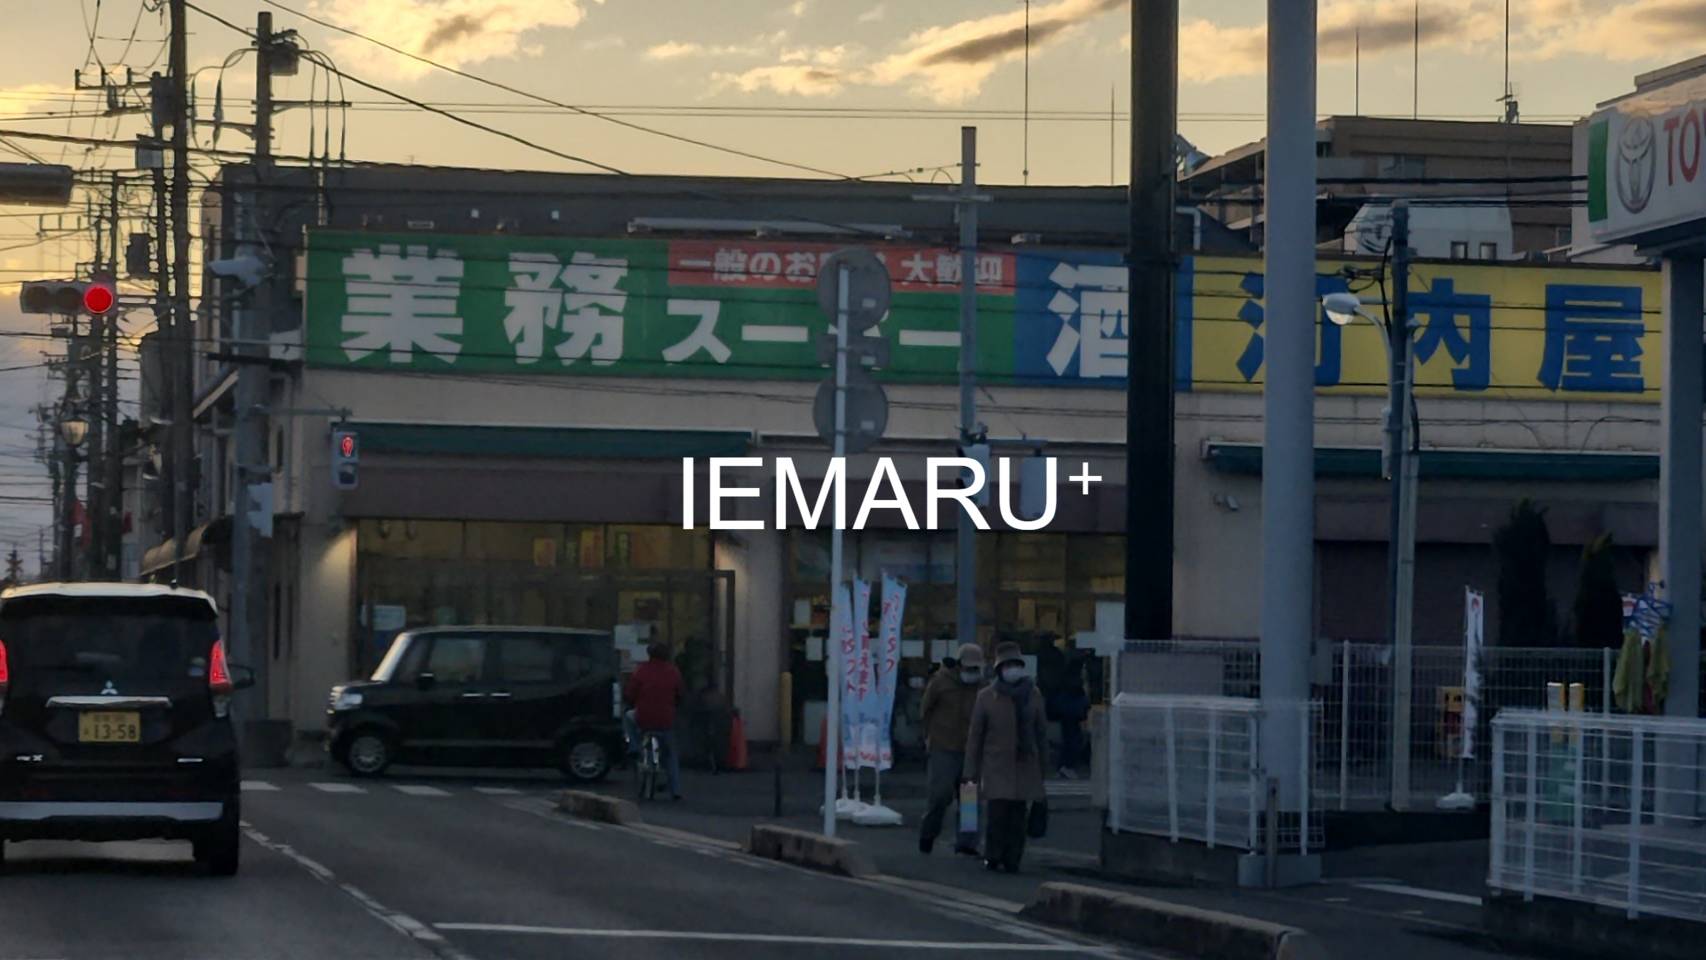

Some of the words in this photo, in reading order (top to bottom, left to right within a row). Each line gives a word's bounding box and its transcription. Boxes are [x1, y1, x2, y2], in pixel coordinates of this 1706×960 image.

[1664, 108, 1706, 187] TO
[679, 247, 886, 283] 一般のお
[341, 243, 962, 369] 業務スーー
